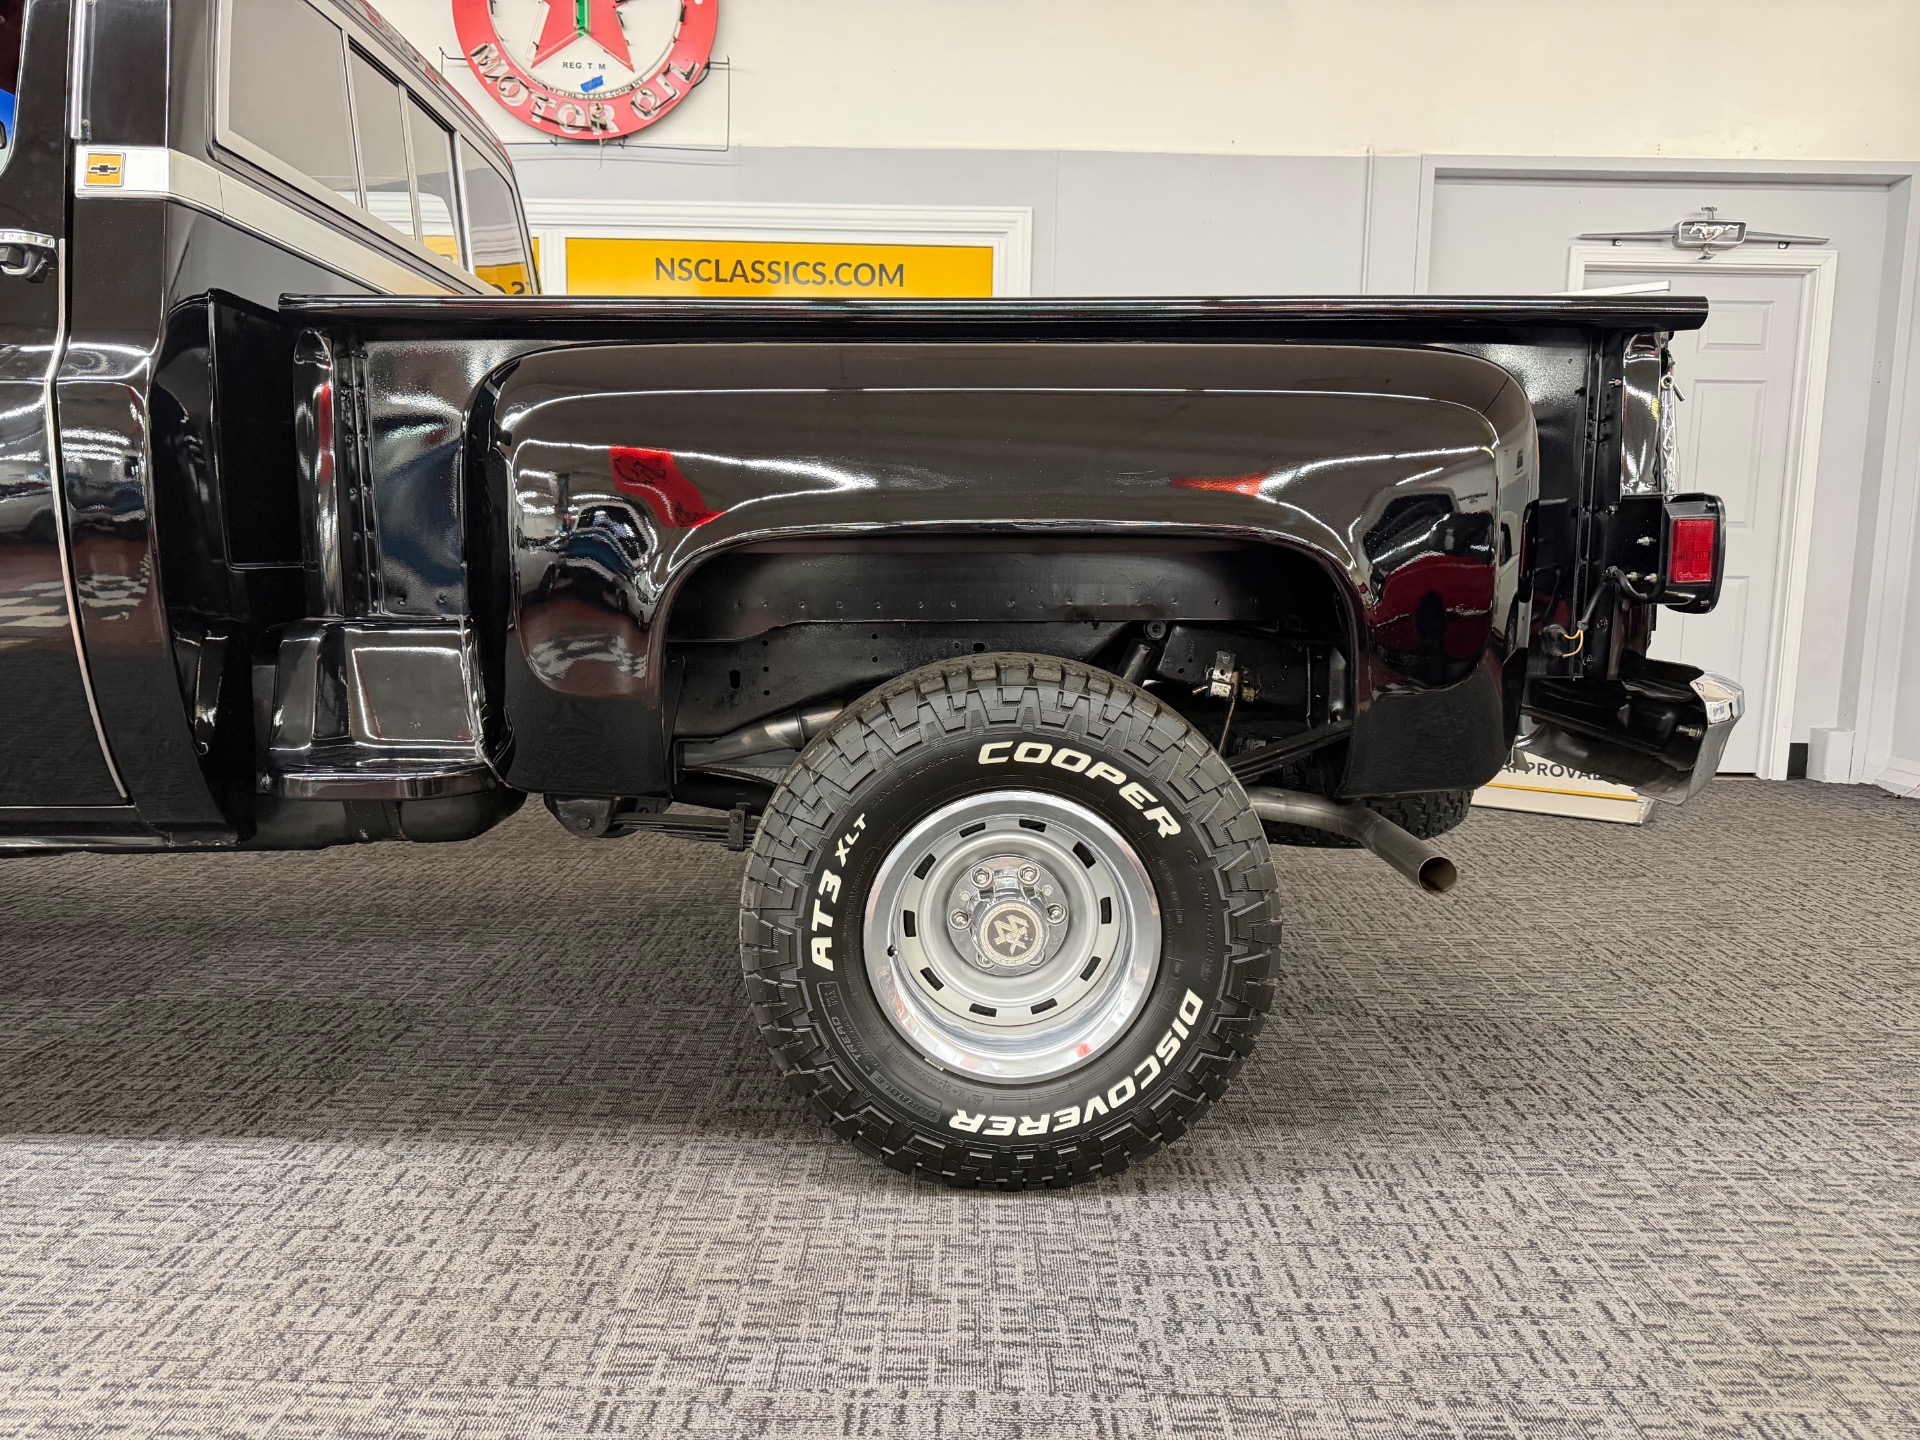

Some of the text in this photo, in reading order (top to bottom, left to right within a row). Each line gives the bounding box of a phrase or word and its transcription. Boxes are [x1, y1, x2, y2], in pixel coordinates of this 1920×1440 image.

[470, 43, 700, 135] MOTOR OIL
[655, 257, 905, 288] NSCLASSICS.COM
[978, 741, 1181, 838] COOPER
[811, 870, 841, 971] AT3
[835, 813, 865, 867] XLT
[830, 1015, 862, 1060] TREAD
[949, 988, 1203, 1136] DISCOVERER
[873, 1074, 937, 1119] DURABLE
